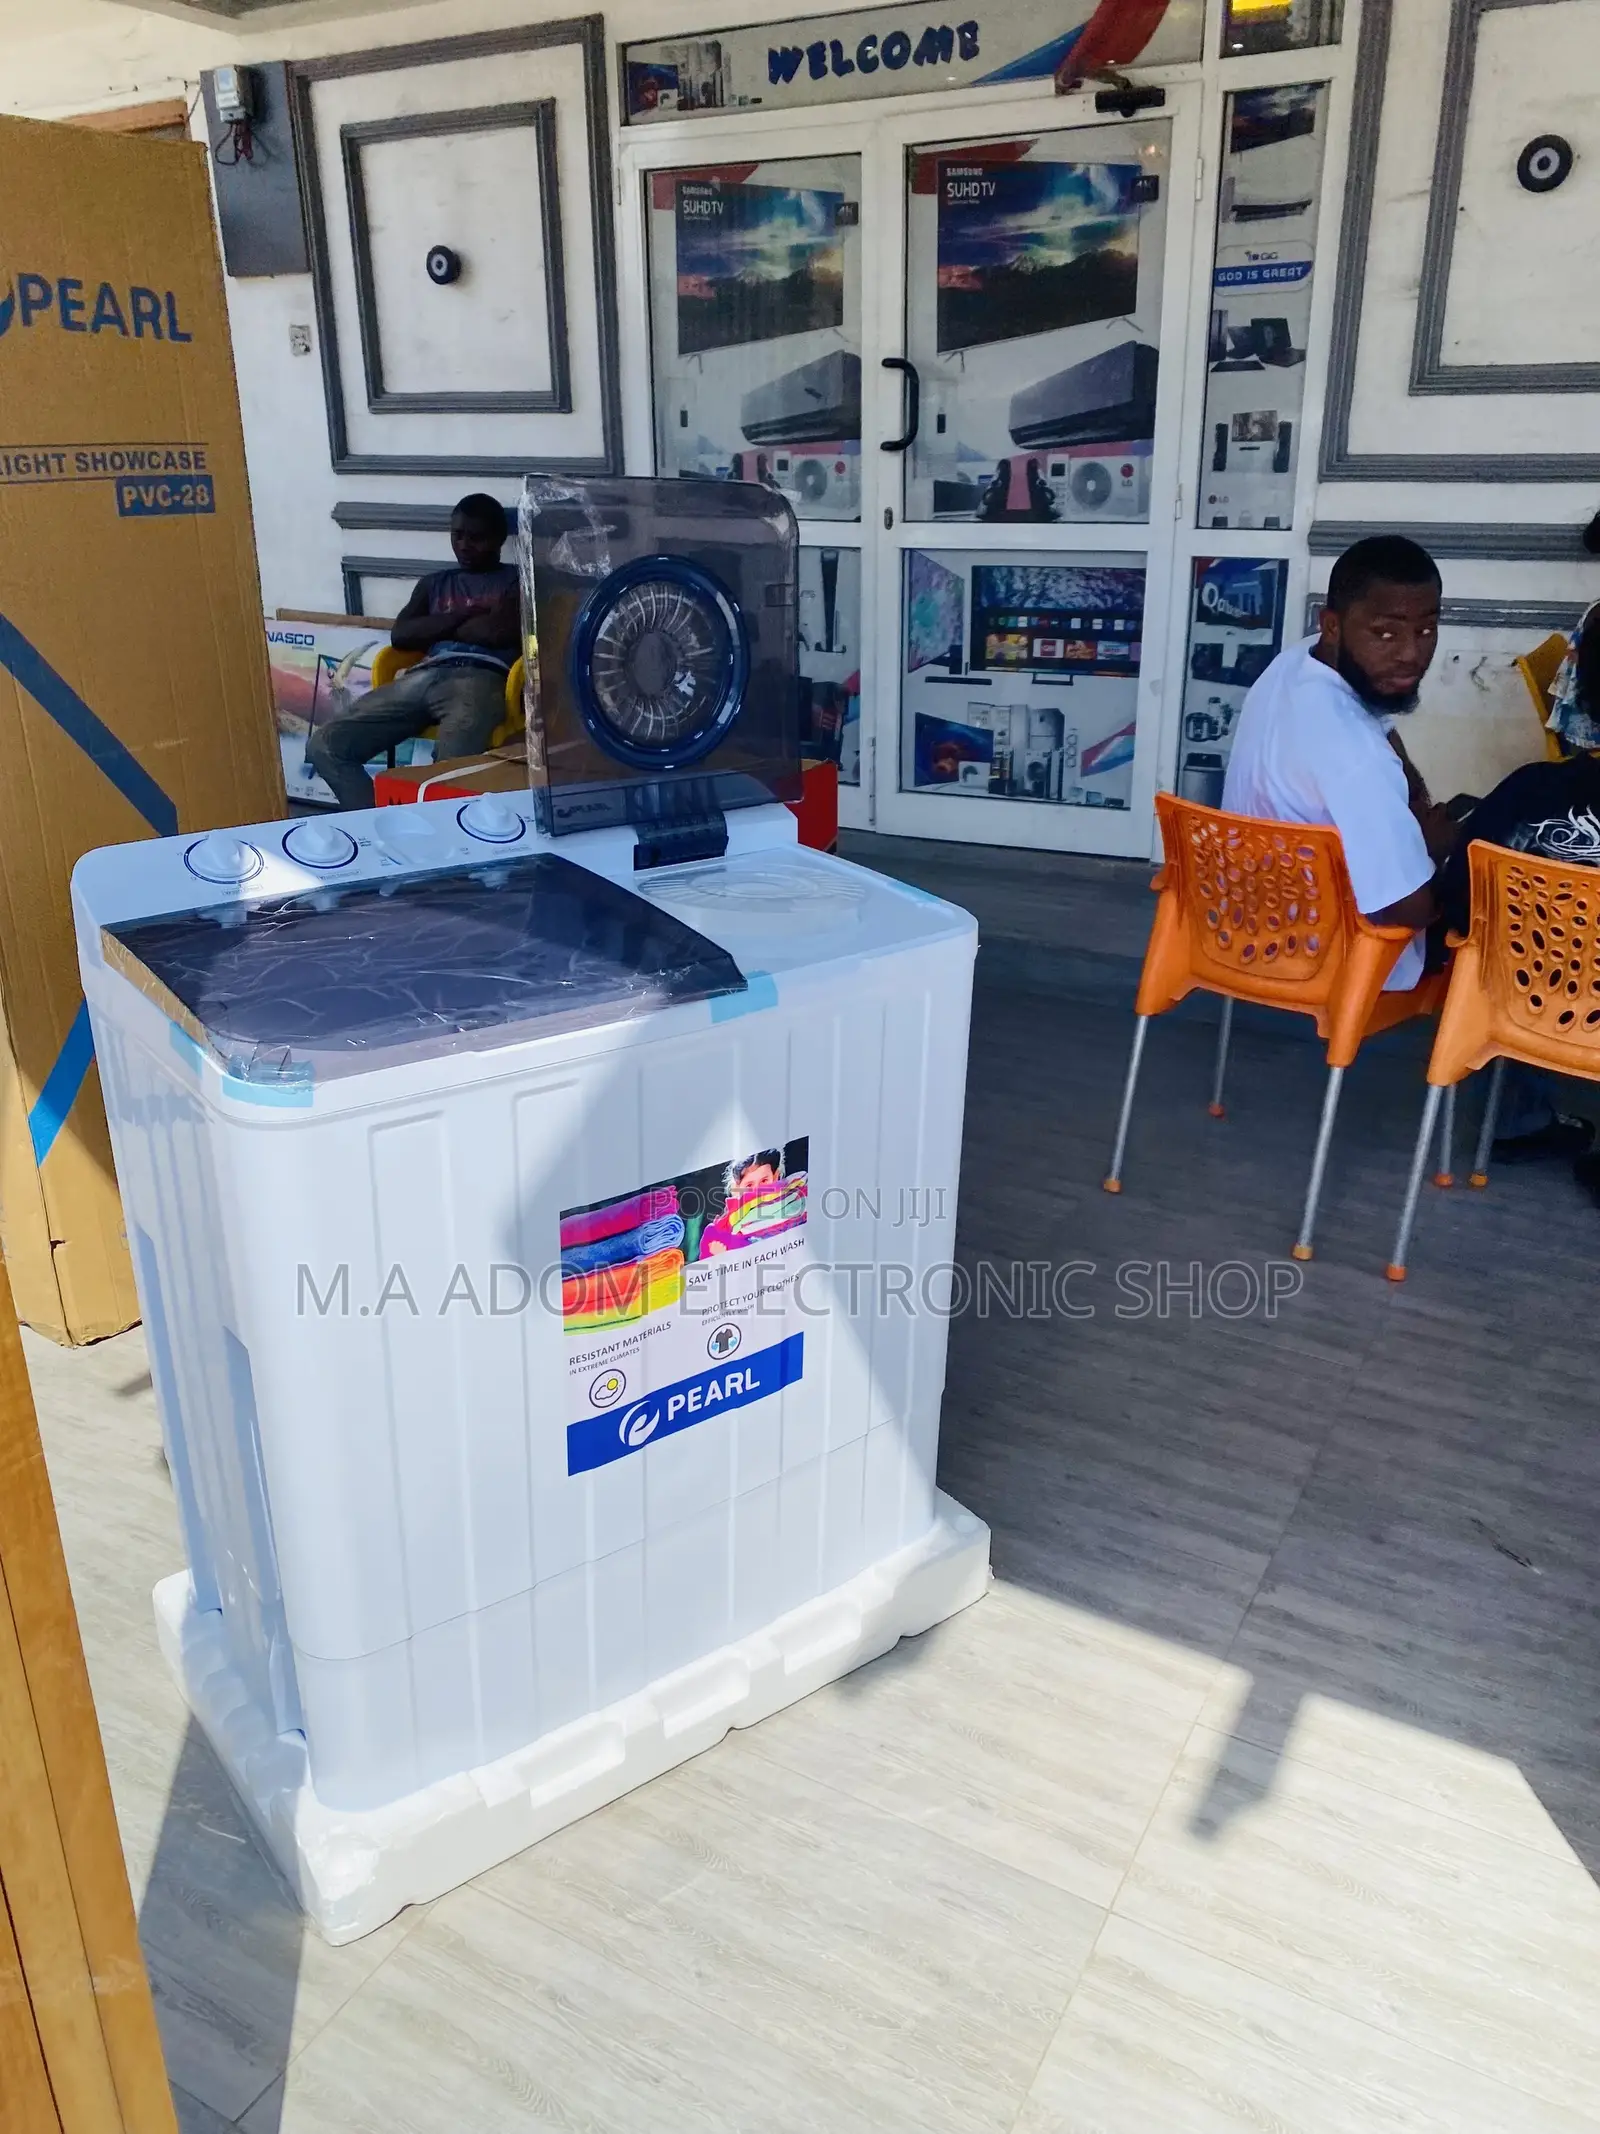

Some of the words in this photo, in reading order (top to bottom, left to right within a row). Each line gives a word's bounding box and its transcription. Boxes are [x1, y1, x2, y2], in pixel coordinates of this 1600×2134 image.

[767, 20, 980, 85] WELCOME
[1218, 271, 1243, 281] GOD
[1247, 270, 1259, 279] IS
[1262, 266, 1303, 278] GREAT
[17, 272, 192, 343] PEARL
[0, 453, 67, 476] IGHT
[75, 451, 207, 472] SHOWCASE
[122, 484, 210, 508] PVC-28
[688, 1271, 713, 1287] SAVE
[715, 1263, 740, 1277] TIME
[742, 1258, 752, 1269] IN
[754, 1249, 778, 1264] EACH
[780, 1238, 805, 1255] WASH
[701, 1297, 741, 1316] PROTECT
[743, 1288, 765, 1301] YOUR
[767, 1273, 800, 1293] CLOTHES
[569, 1342, 620, 1366] RESISTANT
[622, 1321, 672, 1348] MATERIALS
[569, 1367, 577, 1375] IN
[578, 1359, 608, 1373] EXTREME
[610, 1347, 640, 1363] CLIMATES
[667, 1368, 760, 1421] PEARL
